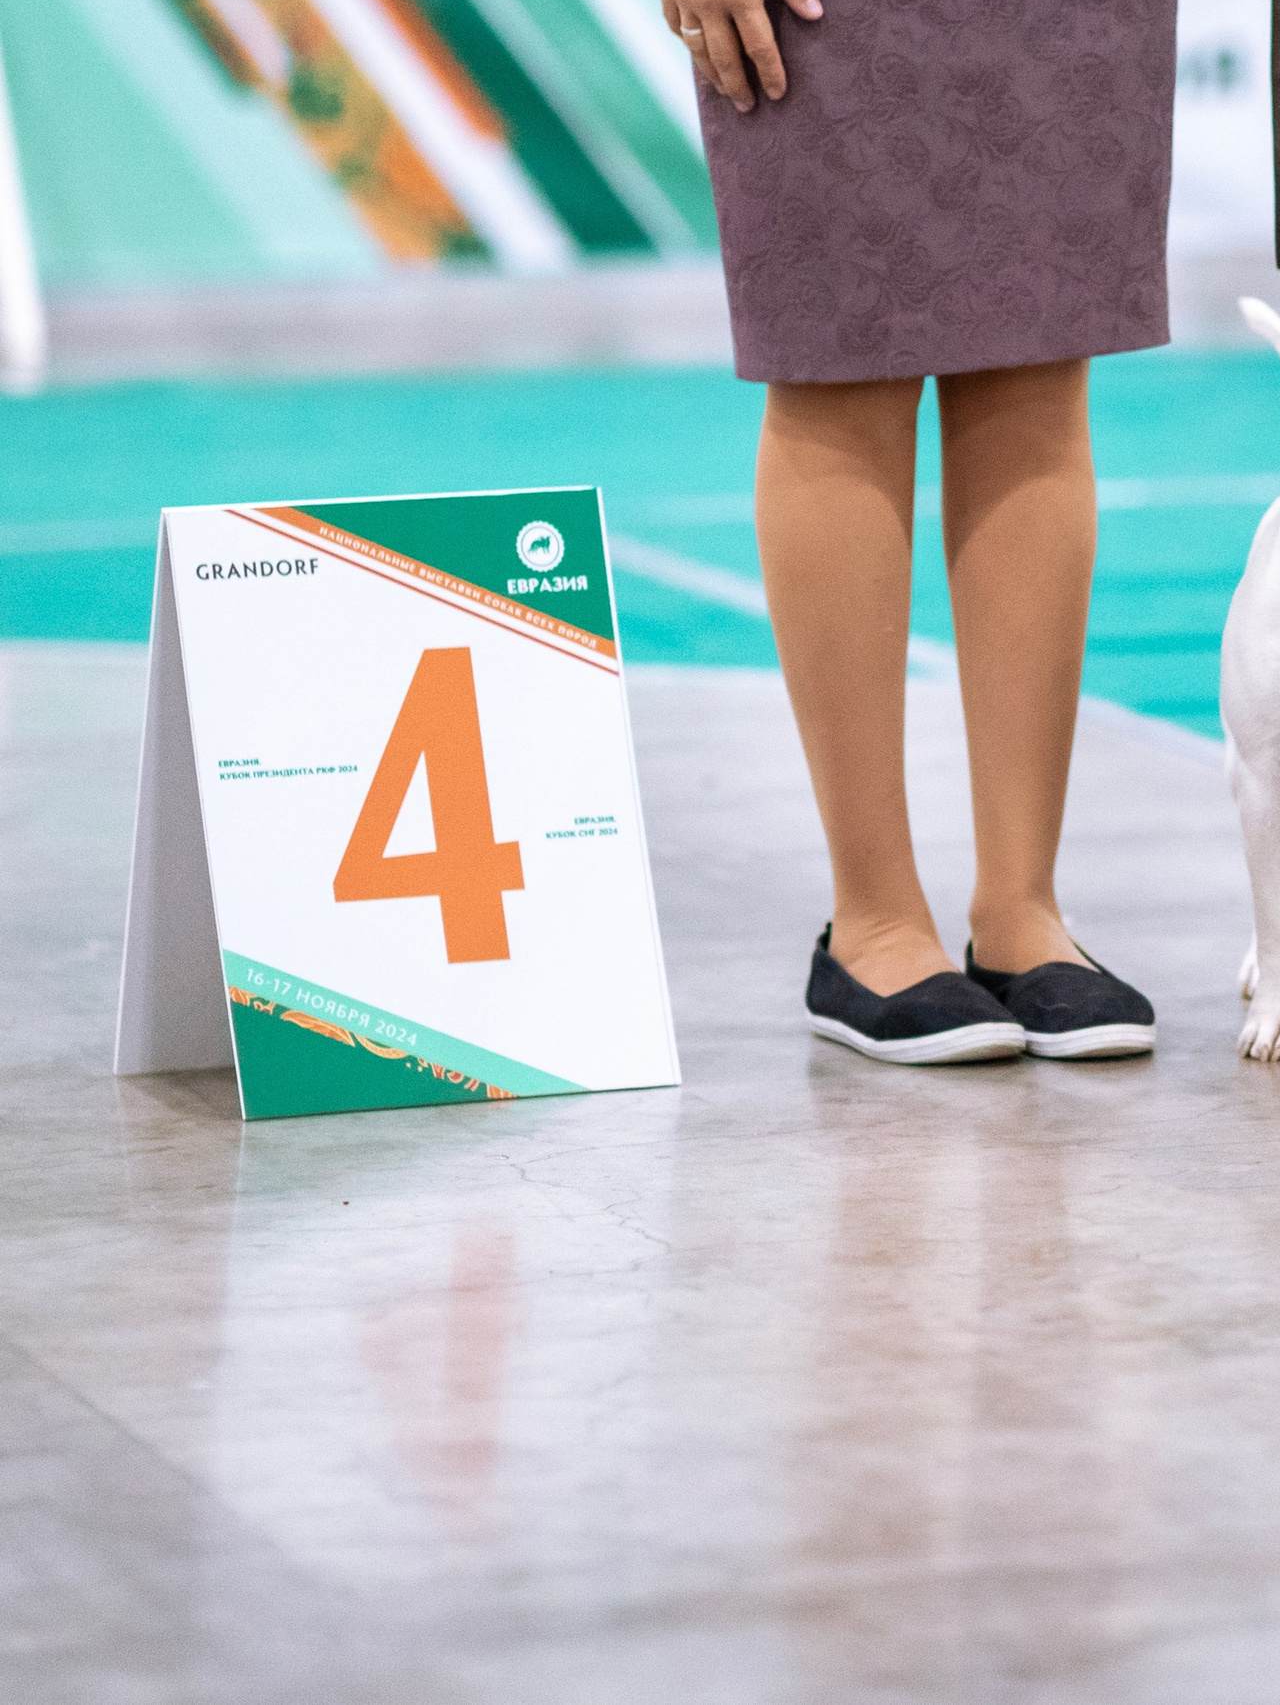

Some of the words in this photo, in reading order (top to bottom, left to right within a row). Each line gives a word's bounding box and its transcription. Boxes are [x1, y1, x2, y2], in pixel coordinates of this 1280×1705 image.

[196, 558, 319, 580] GRANDORF
[319, 526, 416, 573] НАЦИОНАЛЬНЫЕ
[419, 567, 480, 599] ВЫСТАВКИ
[484, 594, 523, 617] СОБАК
[525, 611, 555, 630] ВСЕХ
[557, 625, 597, 649] ПОРОД
[507, 574, 588, 595] ЕВРАЗИЯ
[219, 771, 251, 781] КУБОК
[253, 767, 314, 779] ПРЕЗИДЕНТА
[316, 766, 336, 775] РКФ
[338, 764, 358, 774] 2024
[332, 646, 526, 964] 4
[247, 968, 291, 996] 16-17
[296, 988, 370, 1028] НОЯБРЯ
[374, 1019, 417, 1045] 2024
